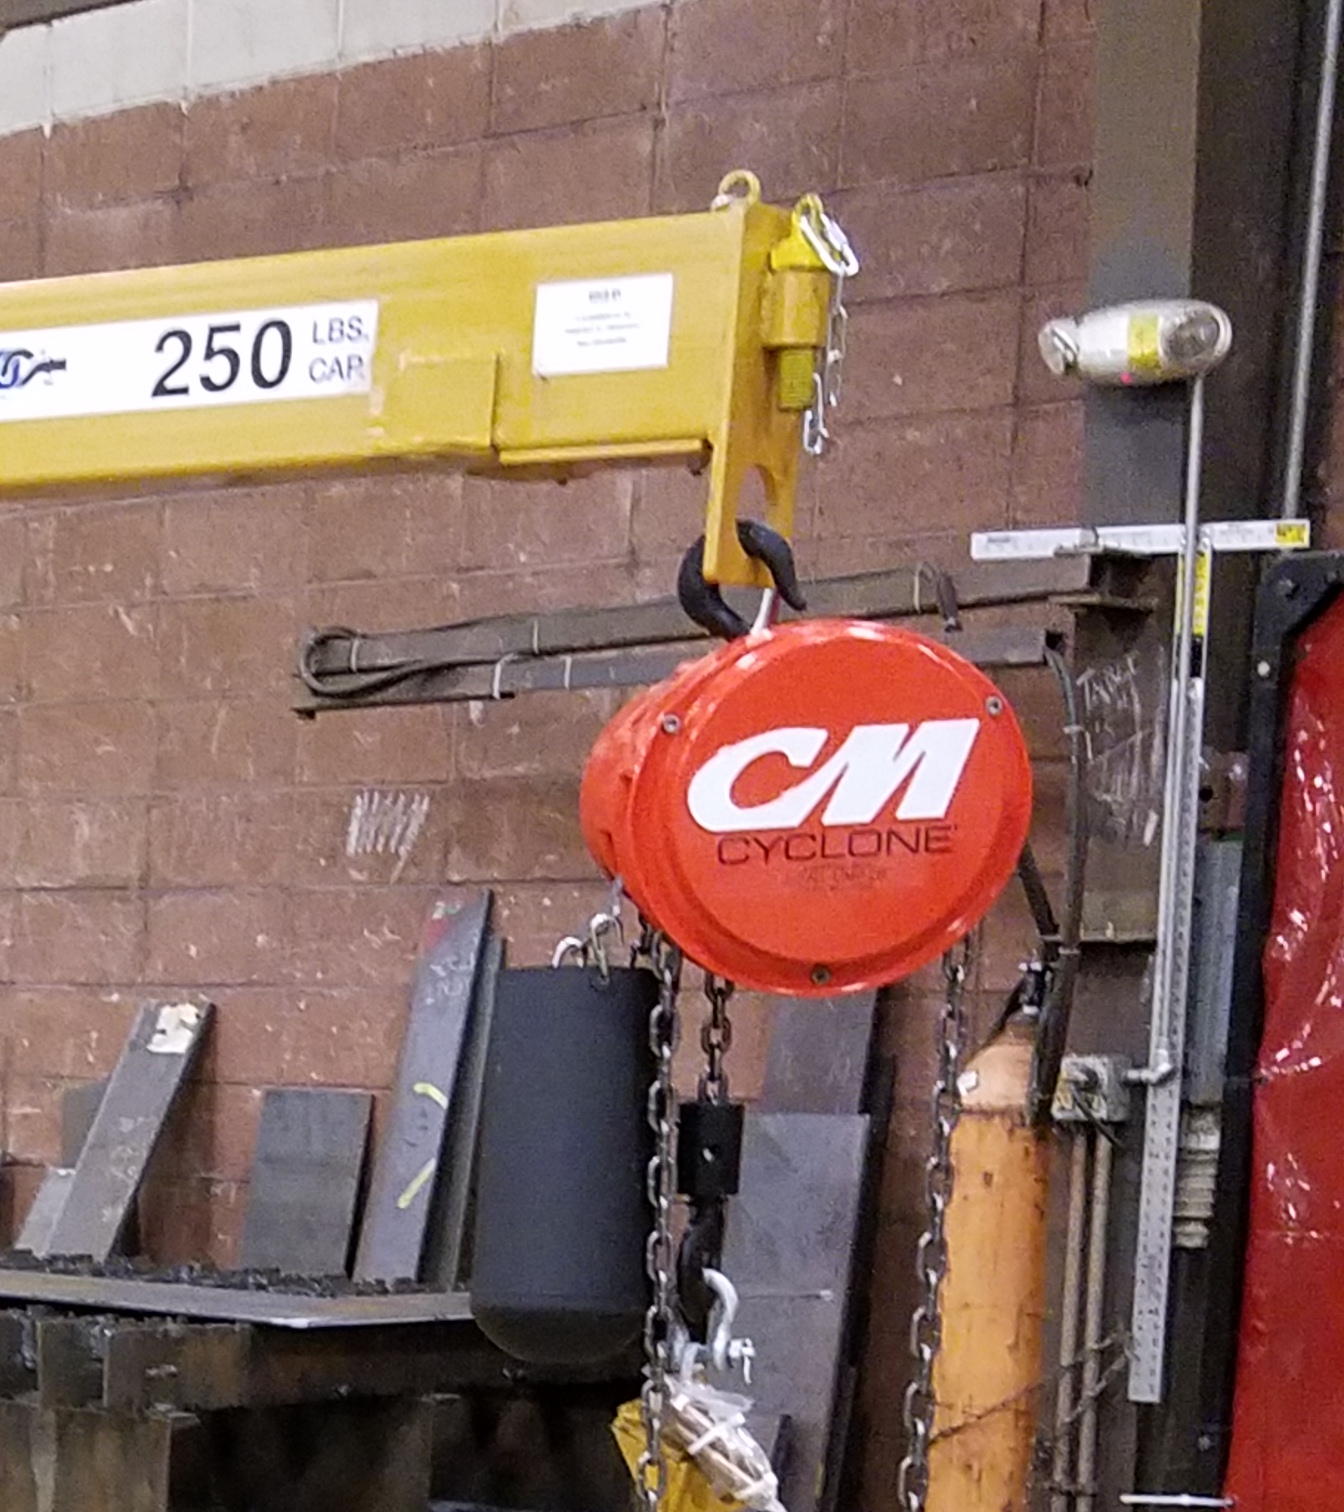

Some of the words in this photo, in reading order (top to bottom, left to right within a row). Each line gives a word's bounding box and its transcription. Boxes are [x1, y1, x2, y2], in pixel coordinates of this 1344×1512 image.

[152, 318, 293, 397] 250
[312, 316, 369, 345] LBS.
[687, 718, 980, 832] CM
[717, 824, 954, 866] CYCLONE
